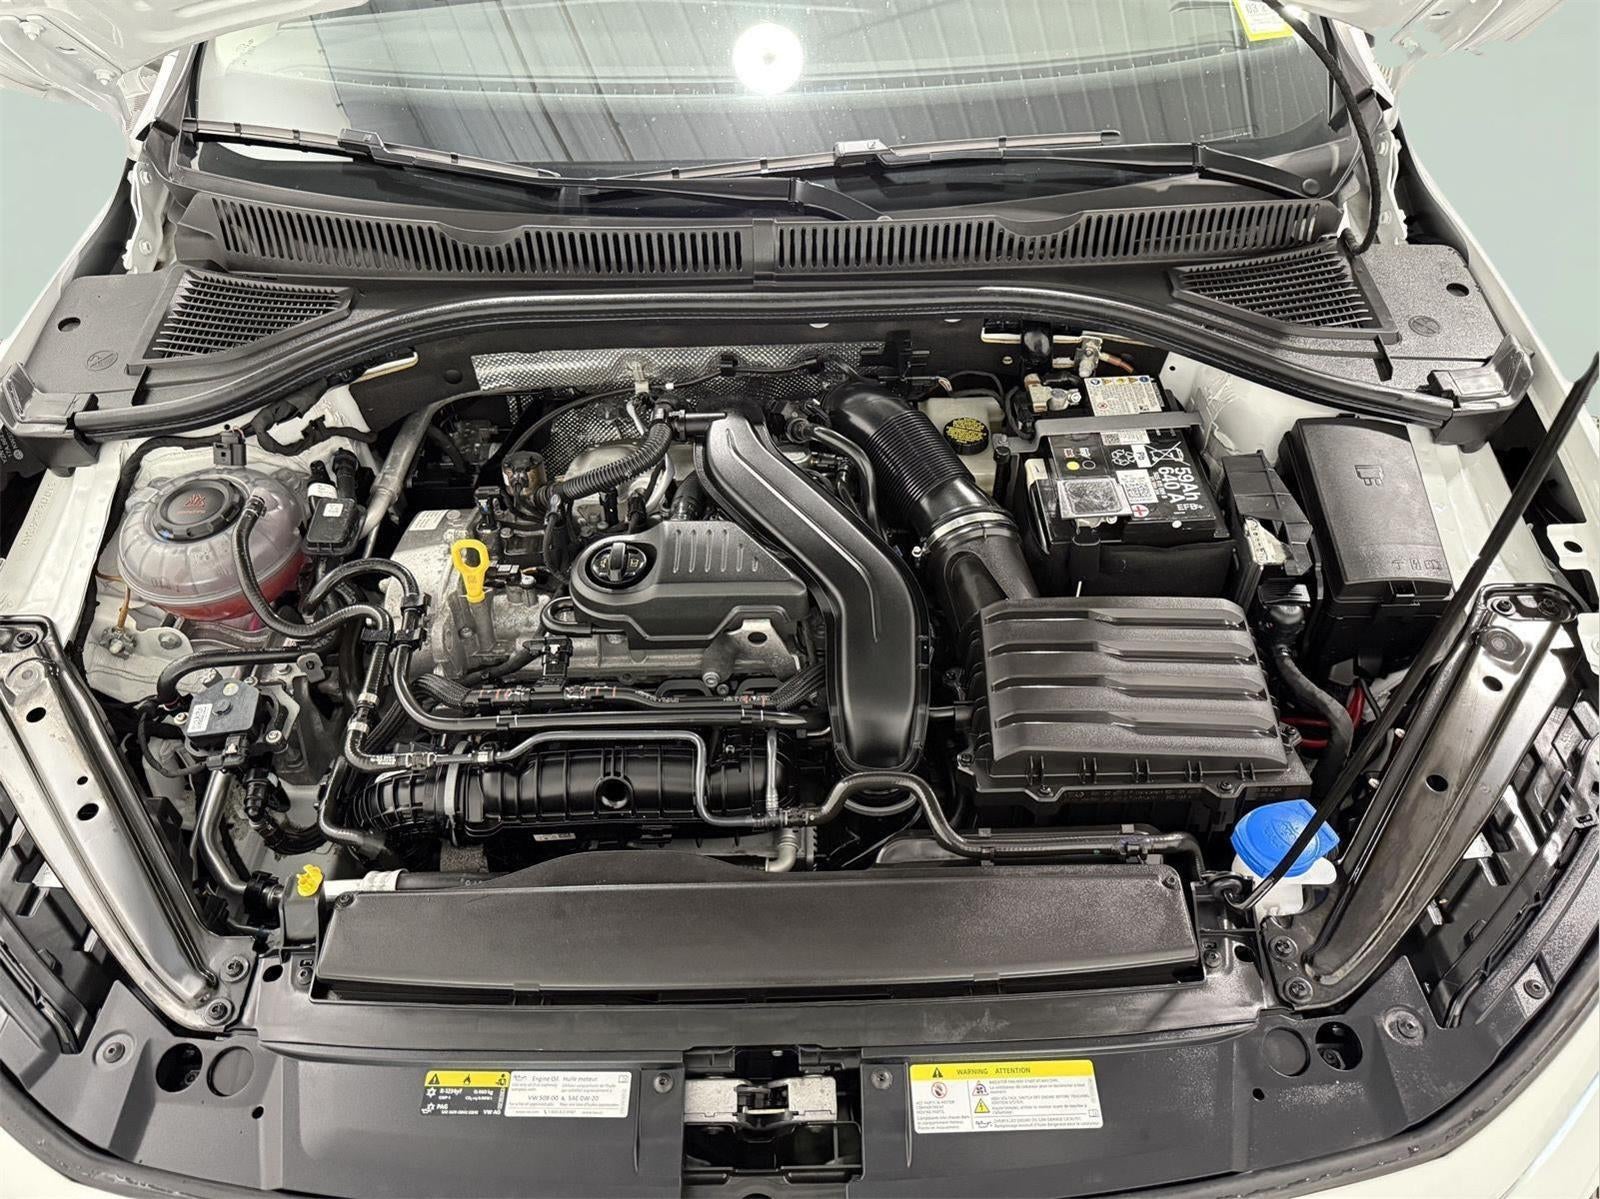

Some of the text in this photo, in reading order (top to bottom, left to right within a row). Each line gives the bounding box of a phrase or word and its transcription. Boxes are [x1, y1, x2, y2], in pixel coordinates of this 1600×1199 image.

[1159, 467, 1180, 490] 640
[1175, 467, 1201, 501] 59Ah
[1167, 493, 1186, 503] A
[956, 1066, 1031, 1076] WARNING ATTENTION
